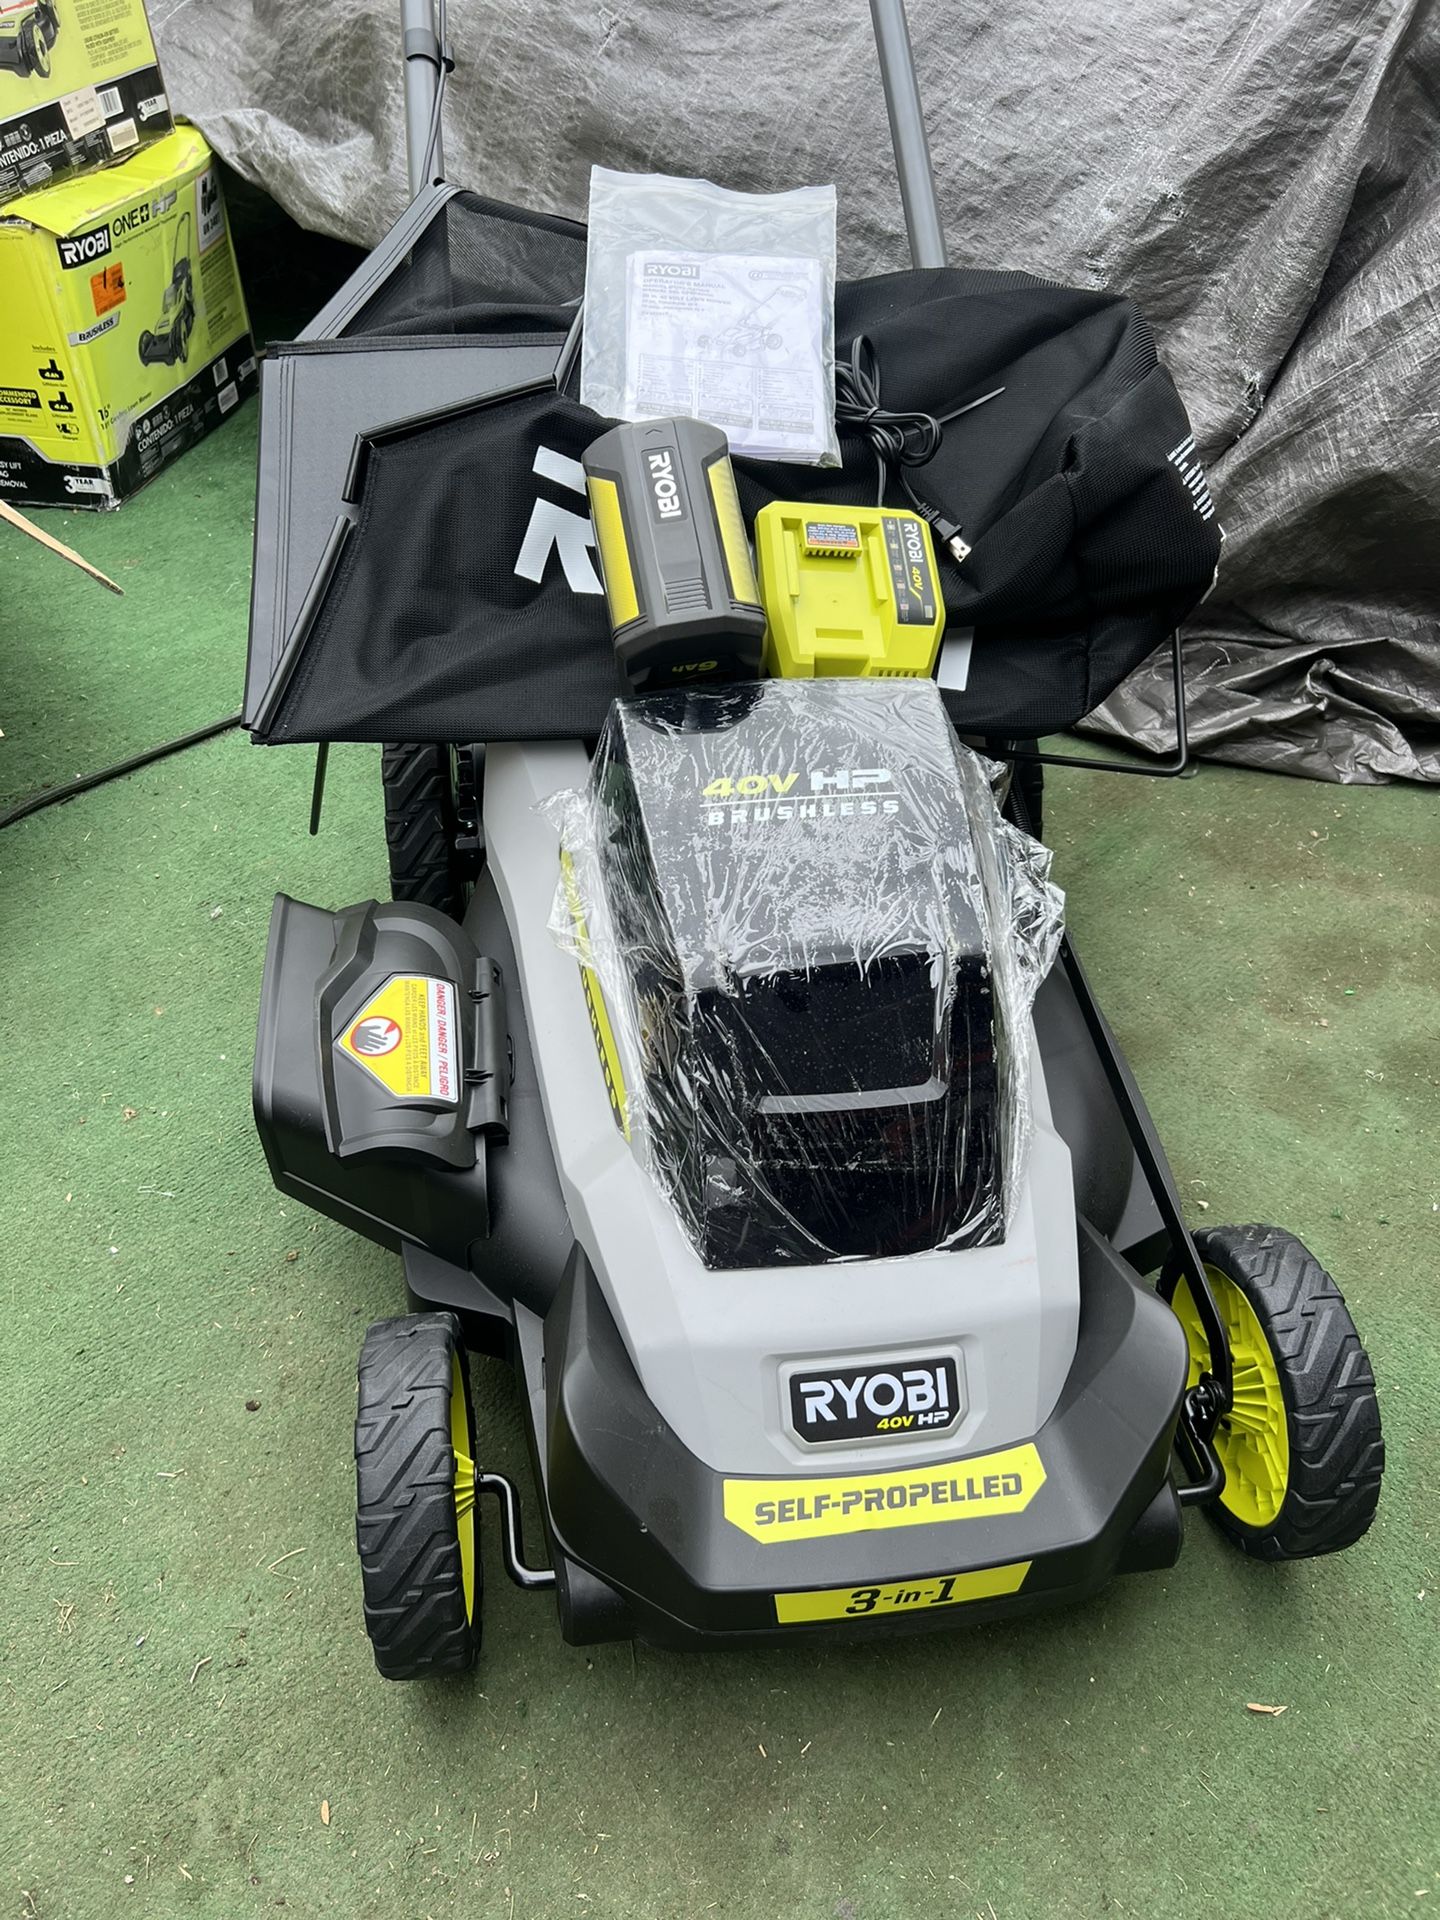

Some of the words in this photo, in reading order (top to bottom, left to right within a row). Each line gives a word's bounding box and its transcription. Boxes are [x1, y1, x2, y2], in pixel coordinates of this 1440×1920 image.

[138, 102, 147, 121] 3
[144, 99, 157, 107] YEAR
[39, 138, 45, 149] 1
[44, 129, 68, 147] PIEZA
[61, 230, 109, 264] RYOBI
[152, 190, 177, 217] HP
[647, 265, 696, 276] RYOBI
[79, 317, 114, 341] BRUSHLESS
[138, 420, 174, 452] CONTENIDO:
[64, 475, 77, 494] 3
[648, 451, 682, 518] RYOBI
[904, 522, 924, 563] RYOBI
[912, 566, 924, 590] 40V
[703, 772, 800, 797] 40V
[810, 768, 892, 790] HP
[708, 800, 899, 826] BRUSHLESS
[436, 984, 446, 1015] DANGER
[437, 1020, 448, 1054] DANGER
[438, 1060, 449, 1096] PELIGRO
[800, 1367, 949, 1424] RYOBI
[877, 1416, 914, 1430] 40V
[917, 1410, 949, 1424] HP
[754, 1472, 1022, 1526] SELF-PROPELLED
[845, 1578, 957, 1614] 3-in-1
